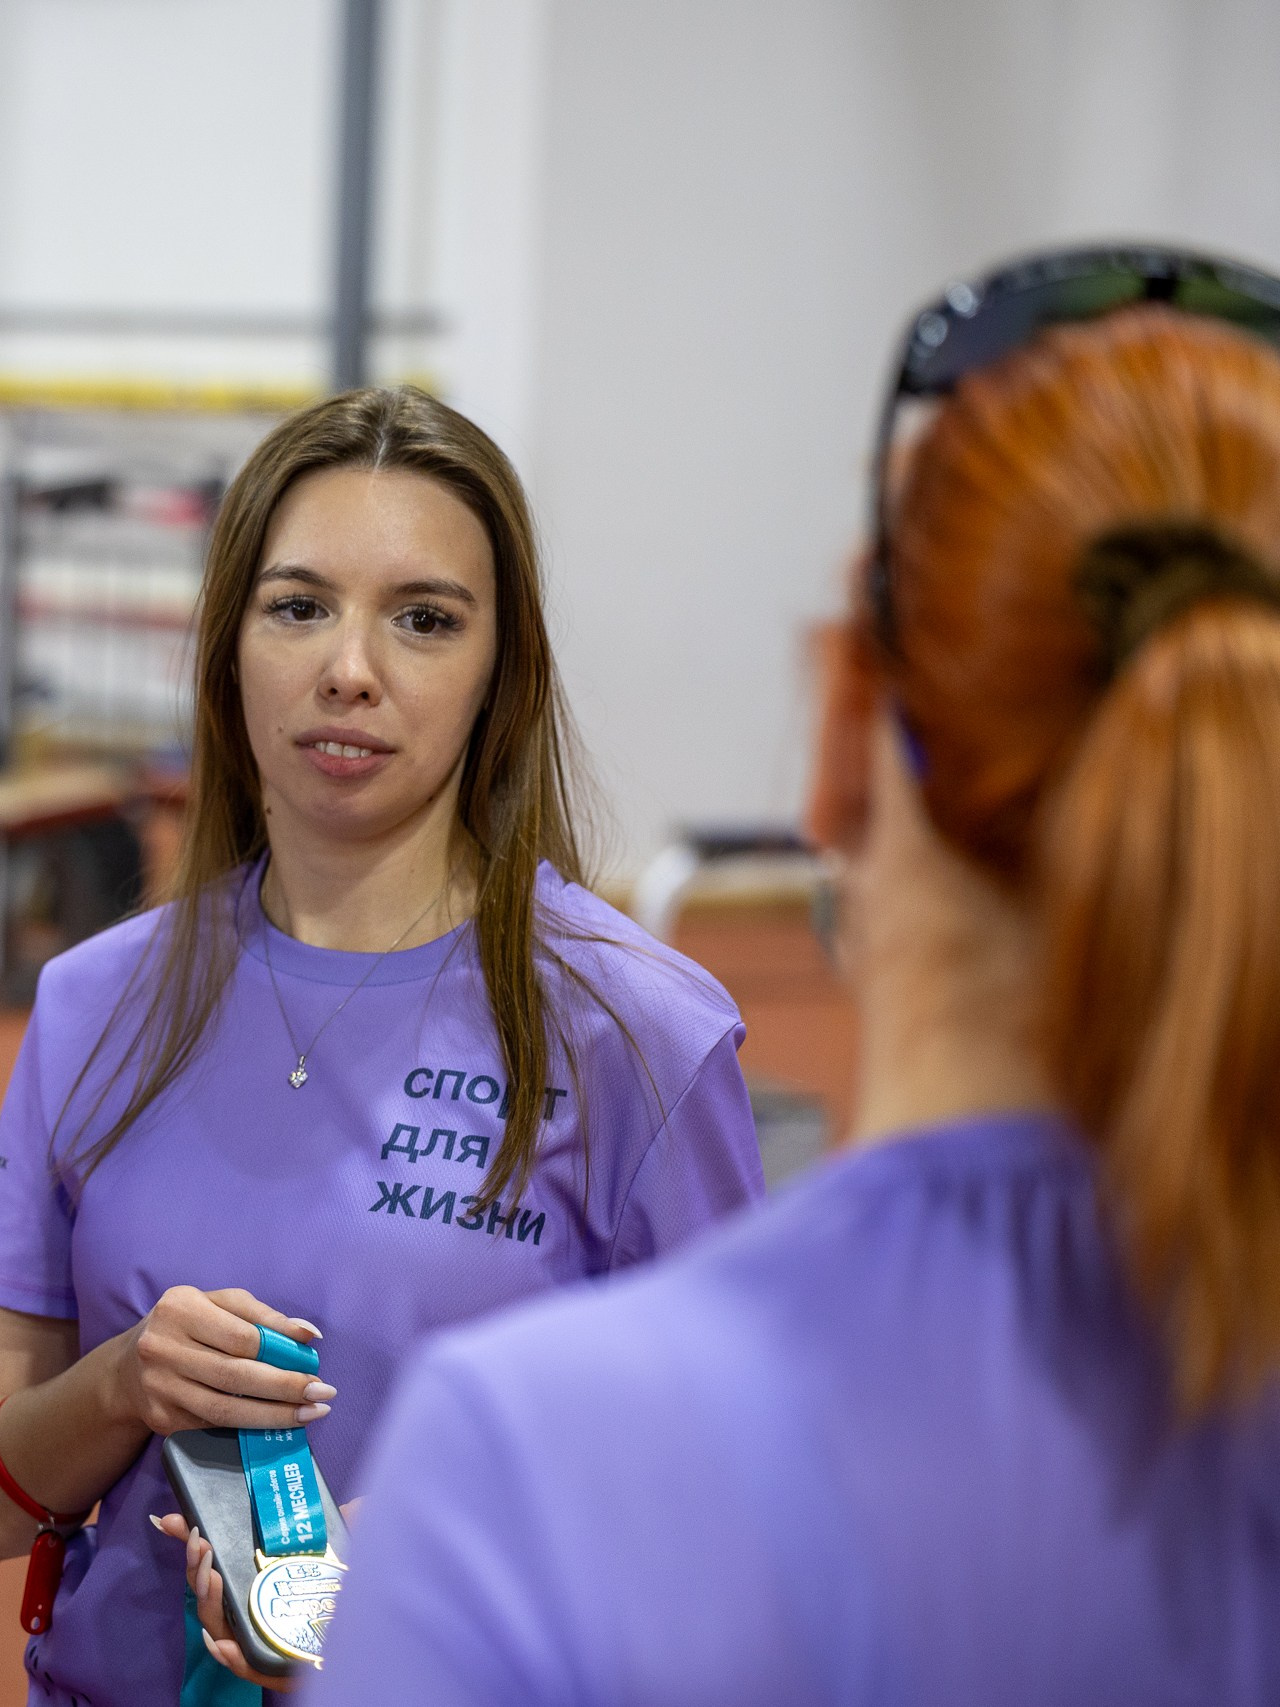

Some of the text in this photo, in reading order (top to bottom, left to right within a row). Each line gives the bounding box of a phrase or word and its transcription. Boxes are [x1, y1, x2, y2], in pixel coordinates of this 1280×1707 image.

[380, 1122, 491, 1170] для
[368, 1180, 547, 1246] жизни
[283, 1462, 311, 1521] МЕСЯЦЕВ
[280, 1516, 291, 1546] Серия
[295, 1520, 314, 1544] 12
